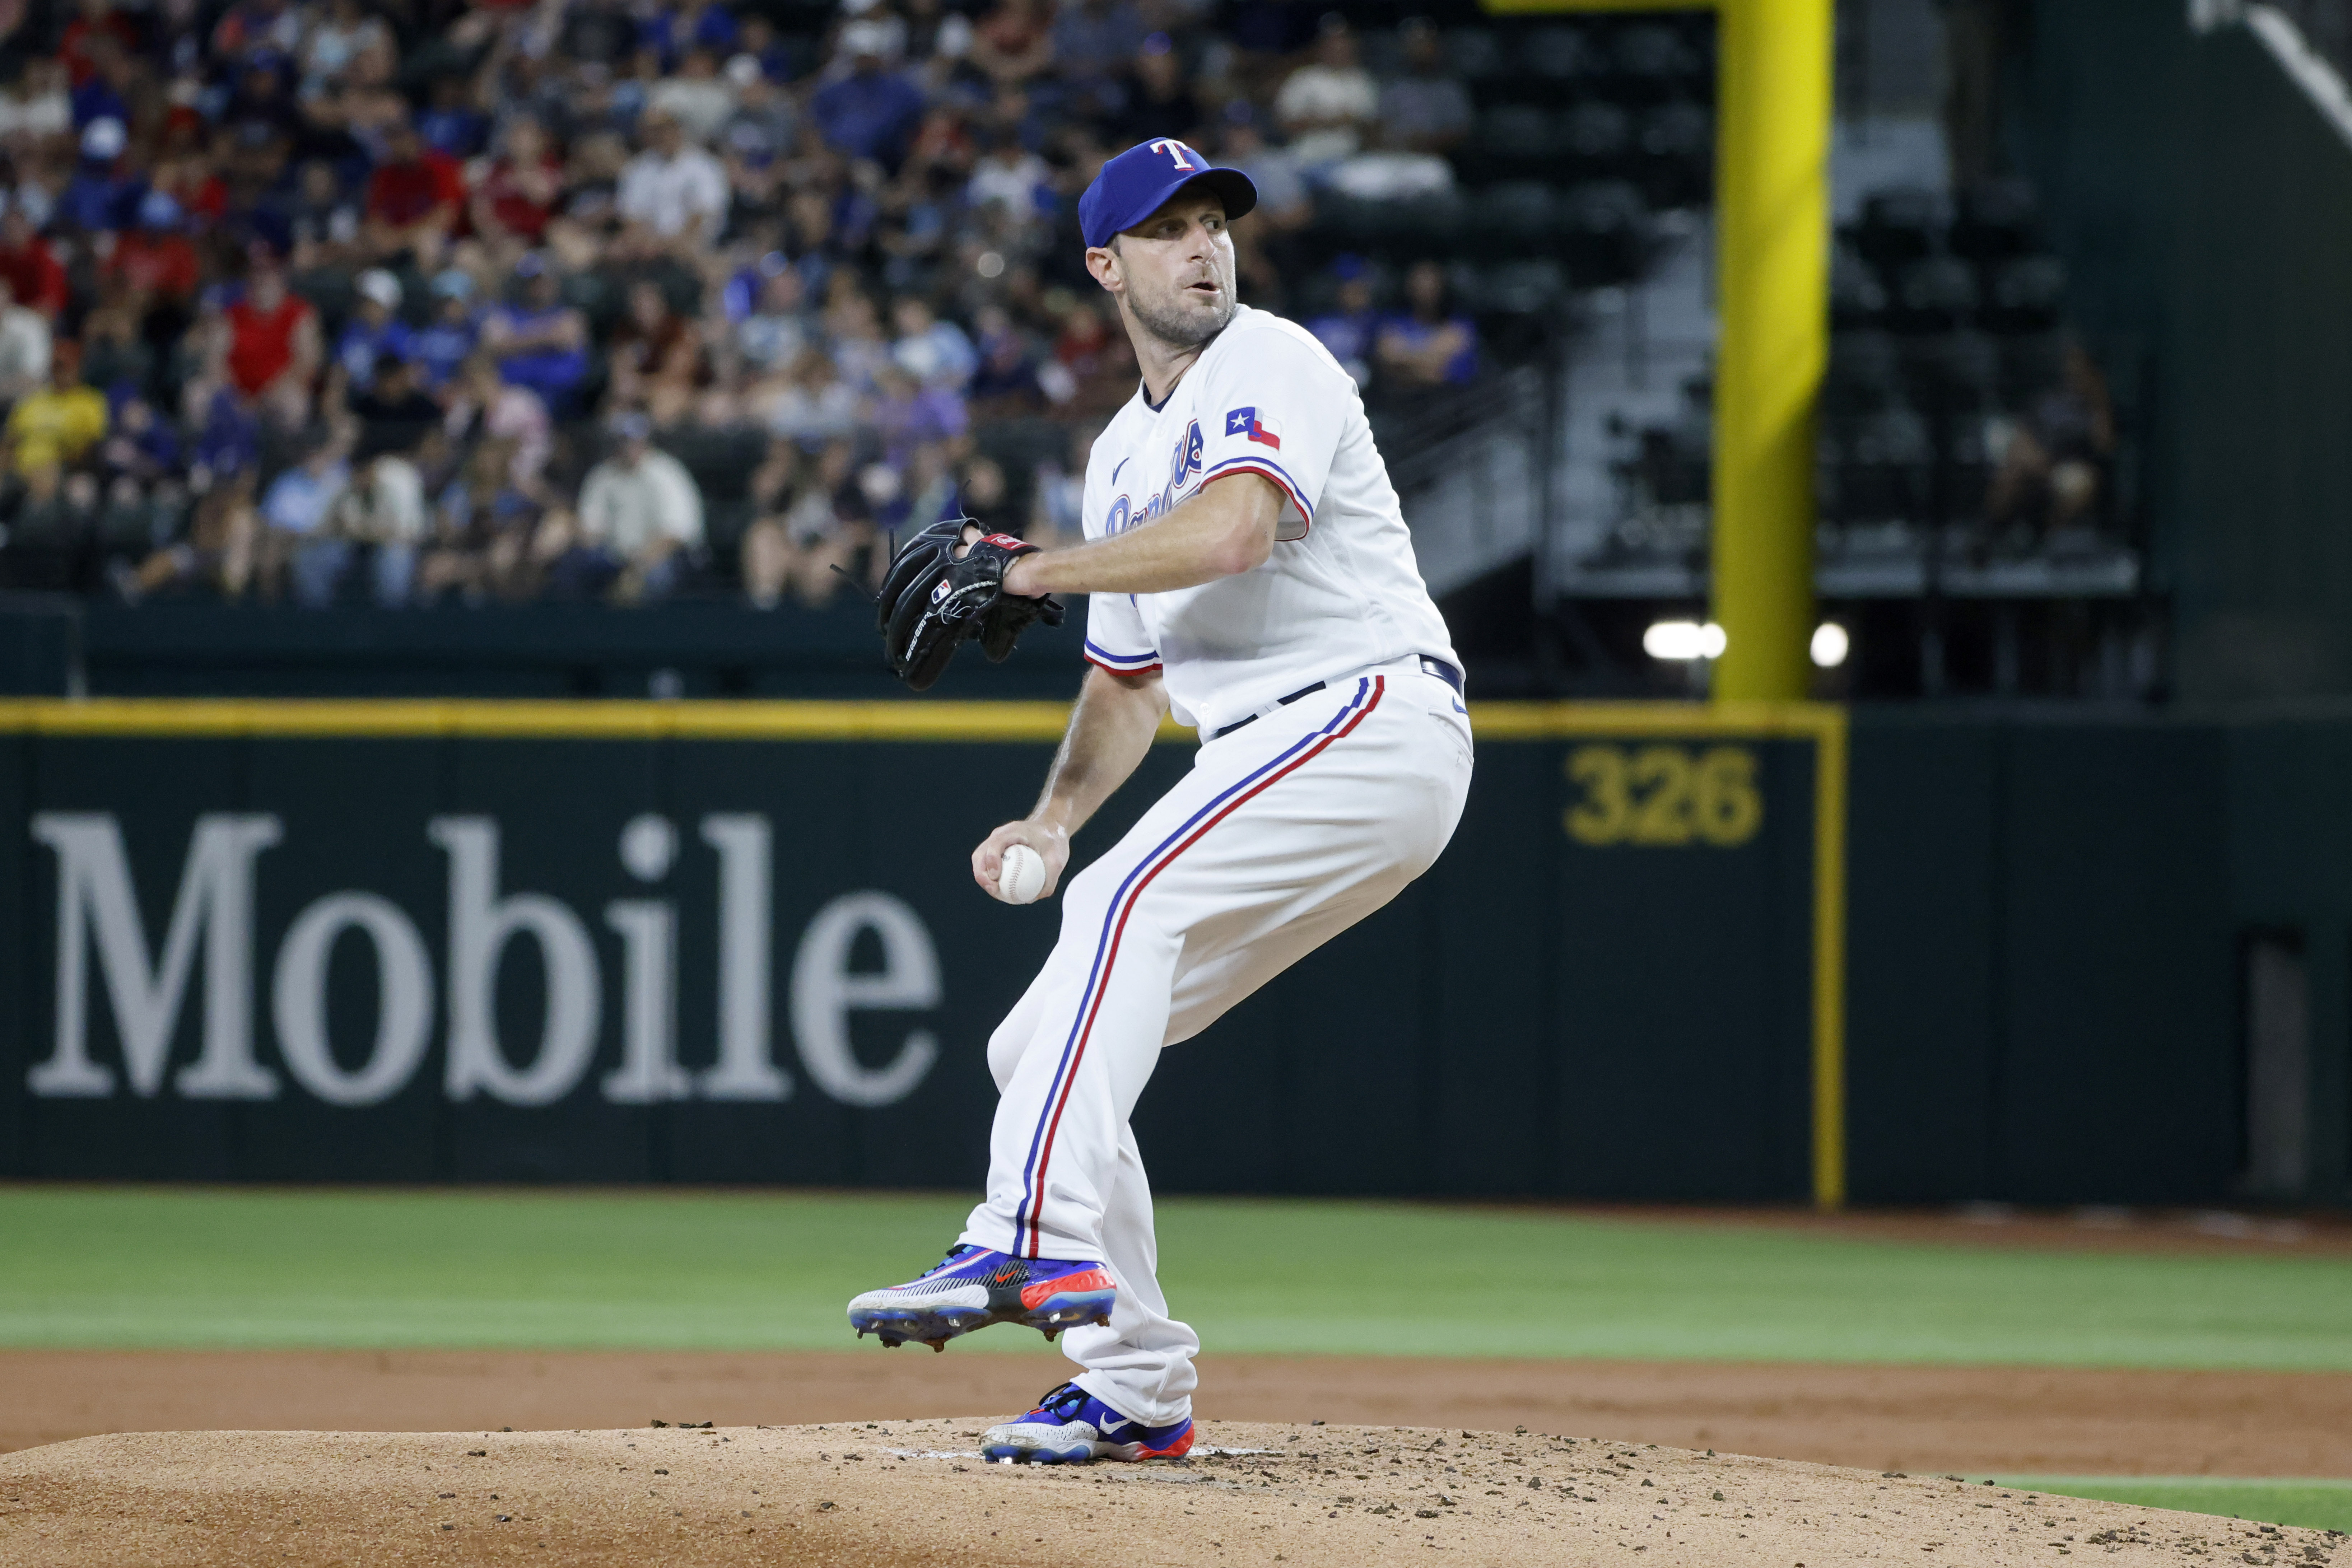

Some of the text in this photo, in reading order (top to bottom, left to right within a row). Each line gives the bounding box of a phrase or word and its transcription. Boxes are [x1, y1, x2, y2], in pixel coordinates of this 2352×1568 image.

[1150, 139, 1195, 171] T
[915, 618, 927, 637] GLOVE
[1564, 747, 1762, 844] 326
[31, 813, 941, 1106] Mobile
